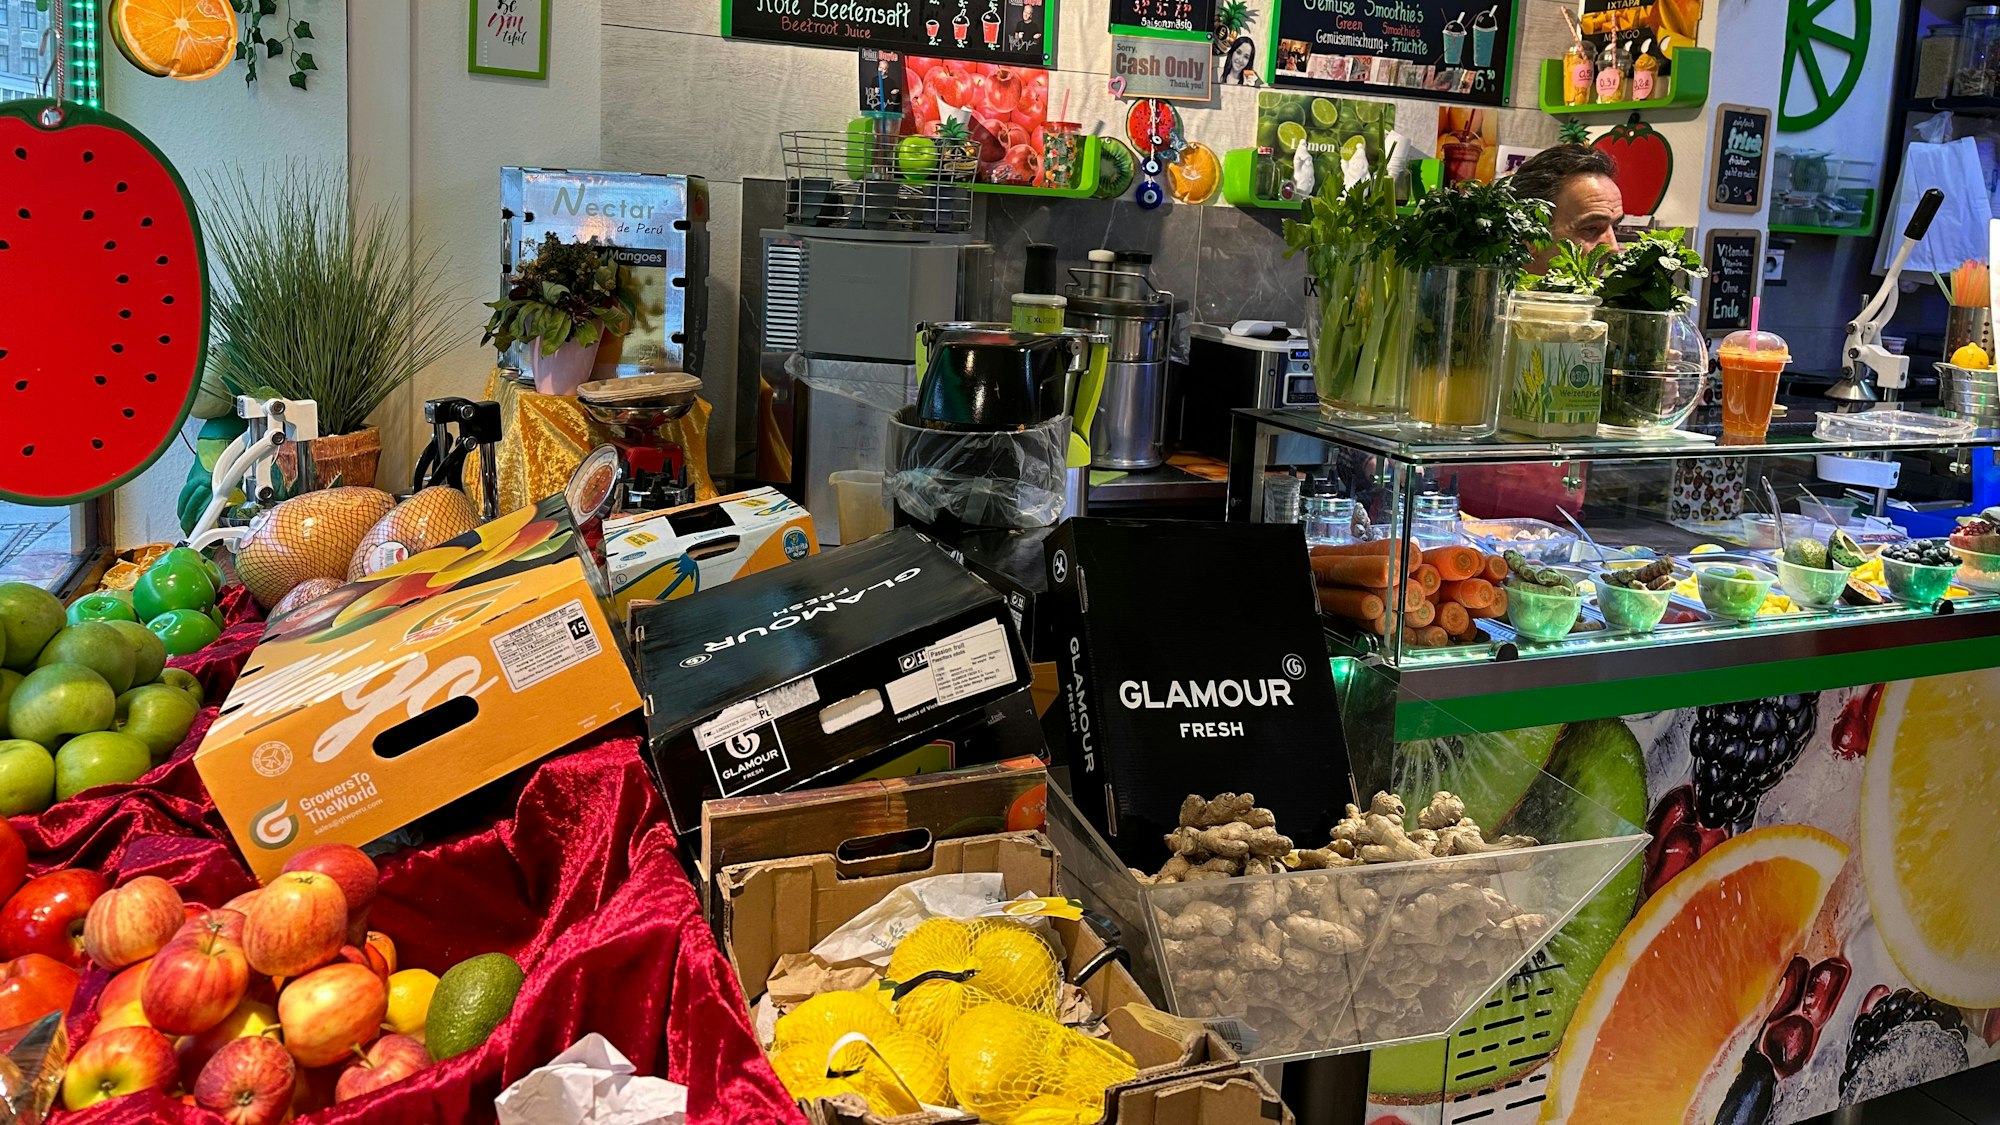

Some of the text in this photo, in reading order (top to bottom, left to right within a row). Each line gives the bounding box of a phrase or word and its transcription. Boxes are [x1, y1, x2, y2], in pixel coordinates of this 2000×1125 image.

[812, 0, 911, 28] Beetensaft
[1607, 0, 1640, 10] IXTAPA
[781, 16, 872, 39] Beetroot Juice
[1335, 15, 1364, 32] Green
[1391, 36, 1428, 56] Früchte
[1603, 30, 1640, 42] MNGO
[1116, 43, 1138, 53] Sorry,
[1116, 53, 1204, 80] Cash Only
[1170, 80, 1204, 90] Thank you!
[1290, 138, 1335, 153] Lmon
[552, 183, 655, 220] Nectar
[617, 222, 663, 235] de Perú
[609, 249, 663, 263] Mangoes
[1721, 280, 1739, 293] Ohne
[1713, 297, 1739, 319] Ende
[704, 567, 921, 652] GLAMOUR
[772, 587, 850, 617] FRESH
[570, 620, 588, 636] 15
[930, 645, 952, 658] Passion
[1119, 679, 1294, 709] GLAMOUR
[897, 710, 920, 723] Product
[926, 702, 939, 711] Viet
[1067, 684, 1079, 733] FRESH
[1070, 636, 1095, 773] GLAMOUR
[1179, 722, 1245, 738] FRESH
[722, 748, 779, 779] GLAMOUR
[743, 767, 765, 780] FRESH
[299, 772, 370, 811] GrowersTo
[305, 782, 378, 824] TheWorld
